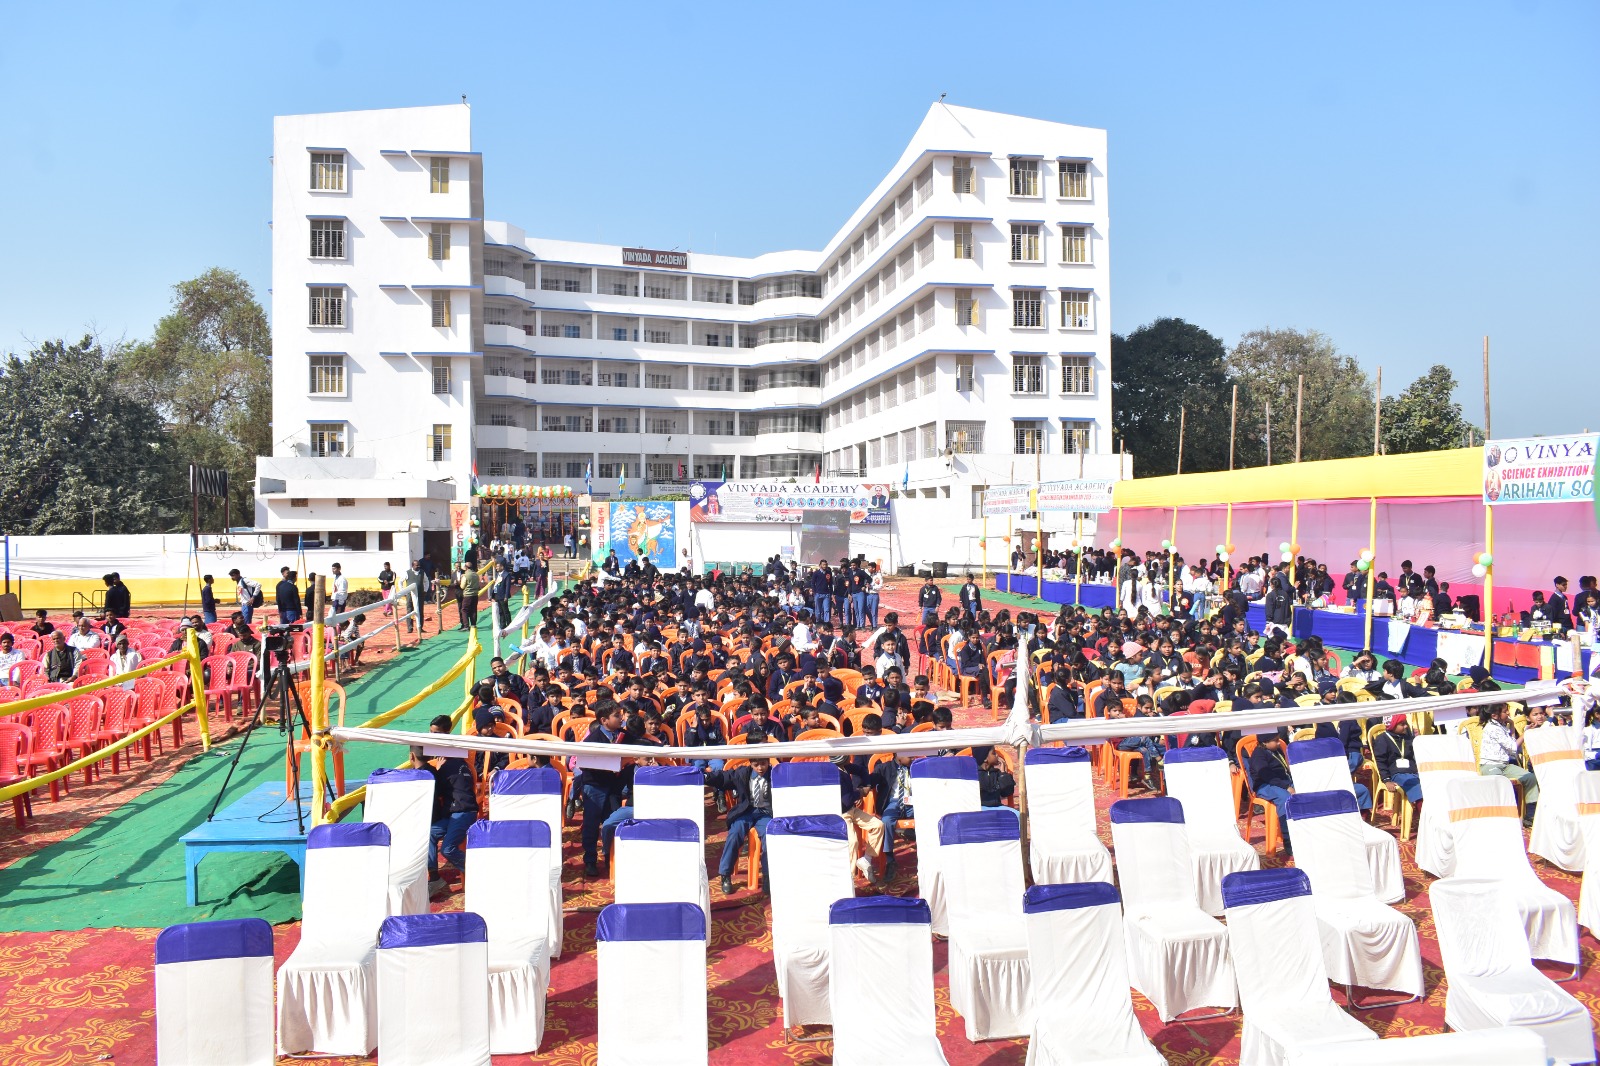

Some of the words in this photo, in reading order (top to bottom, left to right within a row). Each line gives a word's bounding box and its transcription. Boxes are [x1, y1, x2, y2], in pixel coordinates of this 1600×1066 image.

[623, 252, 652, 263] VINYADA
[655, 254, 687, 265] ACADEMY
[1502, 467, 1536, 480] SCIENCE
[1537, 464, 1590, 479] EXHIBITION
[727, 483, 787, 493] VINYADA
[793, 484, 859, 494] ACADEMY
[1503, 481, 1566, 499] ARIHANT
[455, 510, 464, 563] WELCOME
